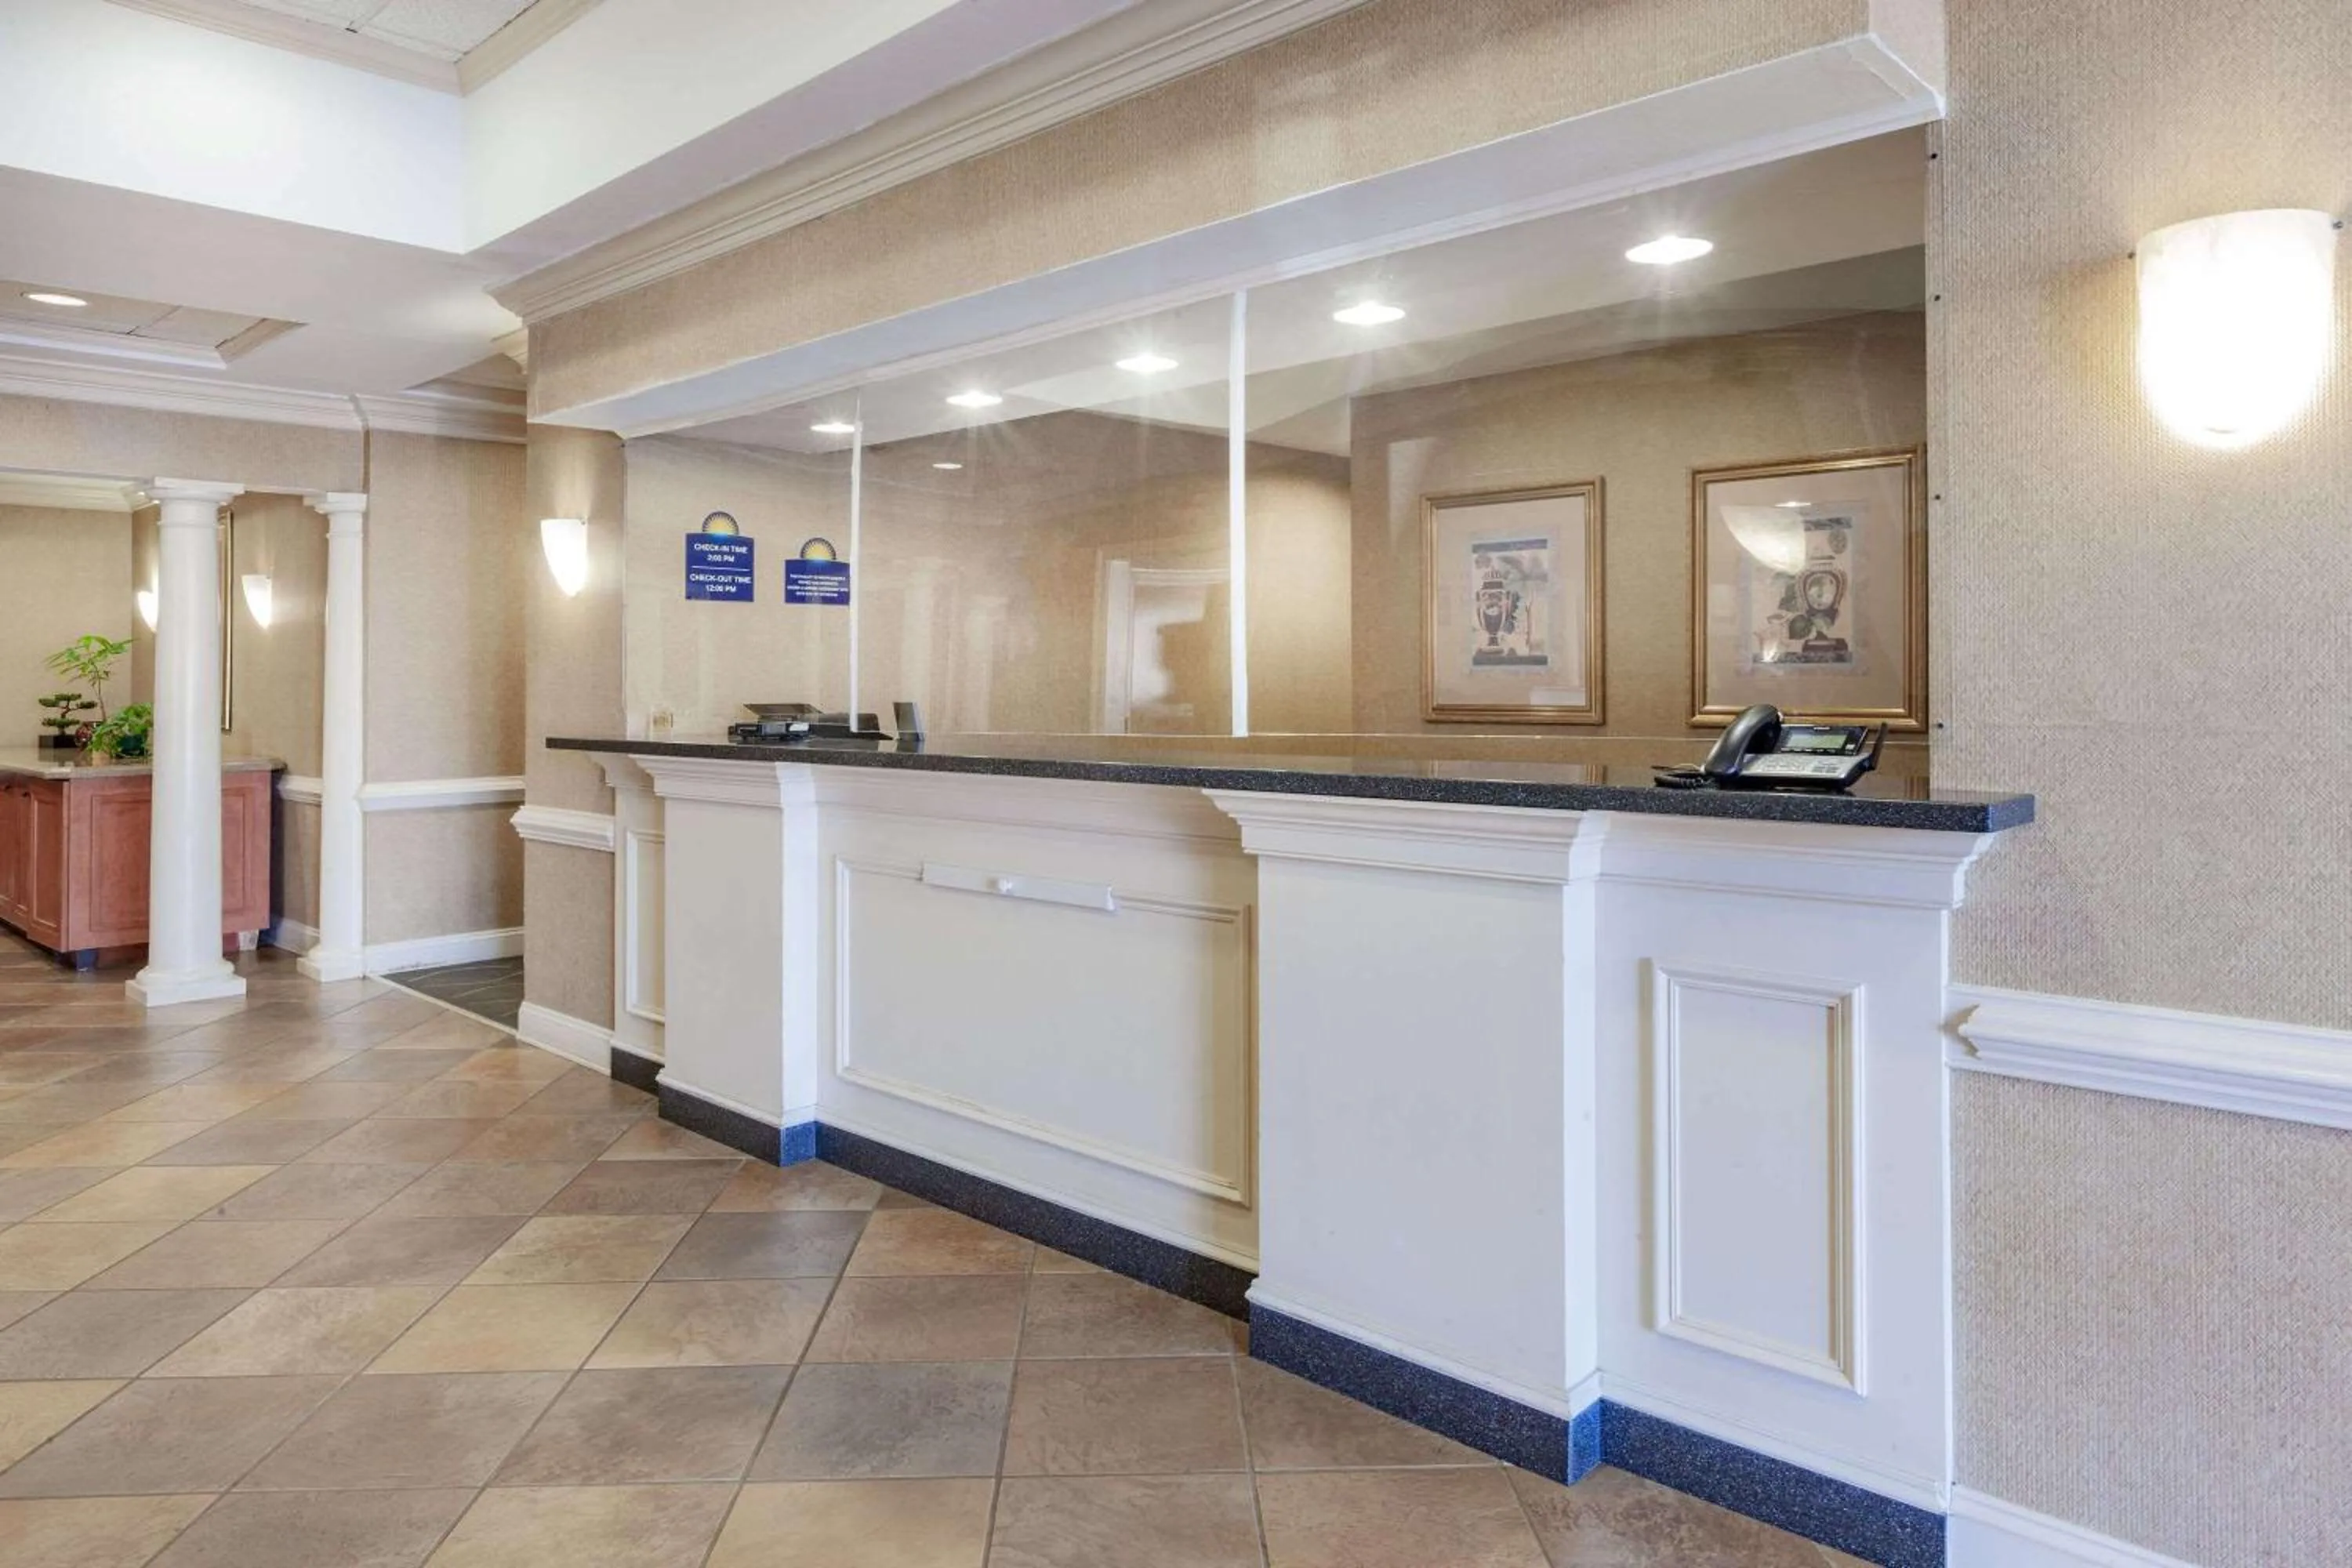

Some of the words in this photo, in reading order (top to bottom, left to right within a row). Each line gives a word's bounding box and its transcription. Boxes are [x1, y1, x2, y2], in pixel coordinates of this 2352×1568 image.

[694, 543, 729, 552] CHECK-IN
[731, 545, 748, 554] TIME
[689, 573, 732, 582] CHECK-OUT
